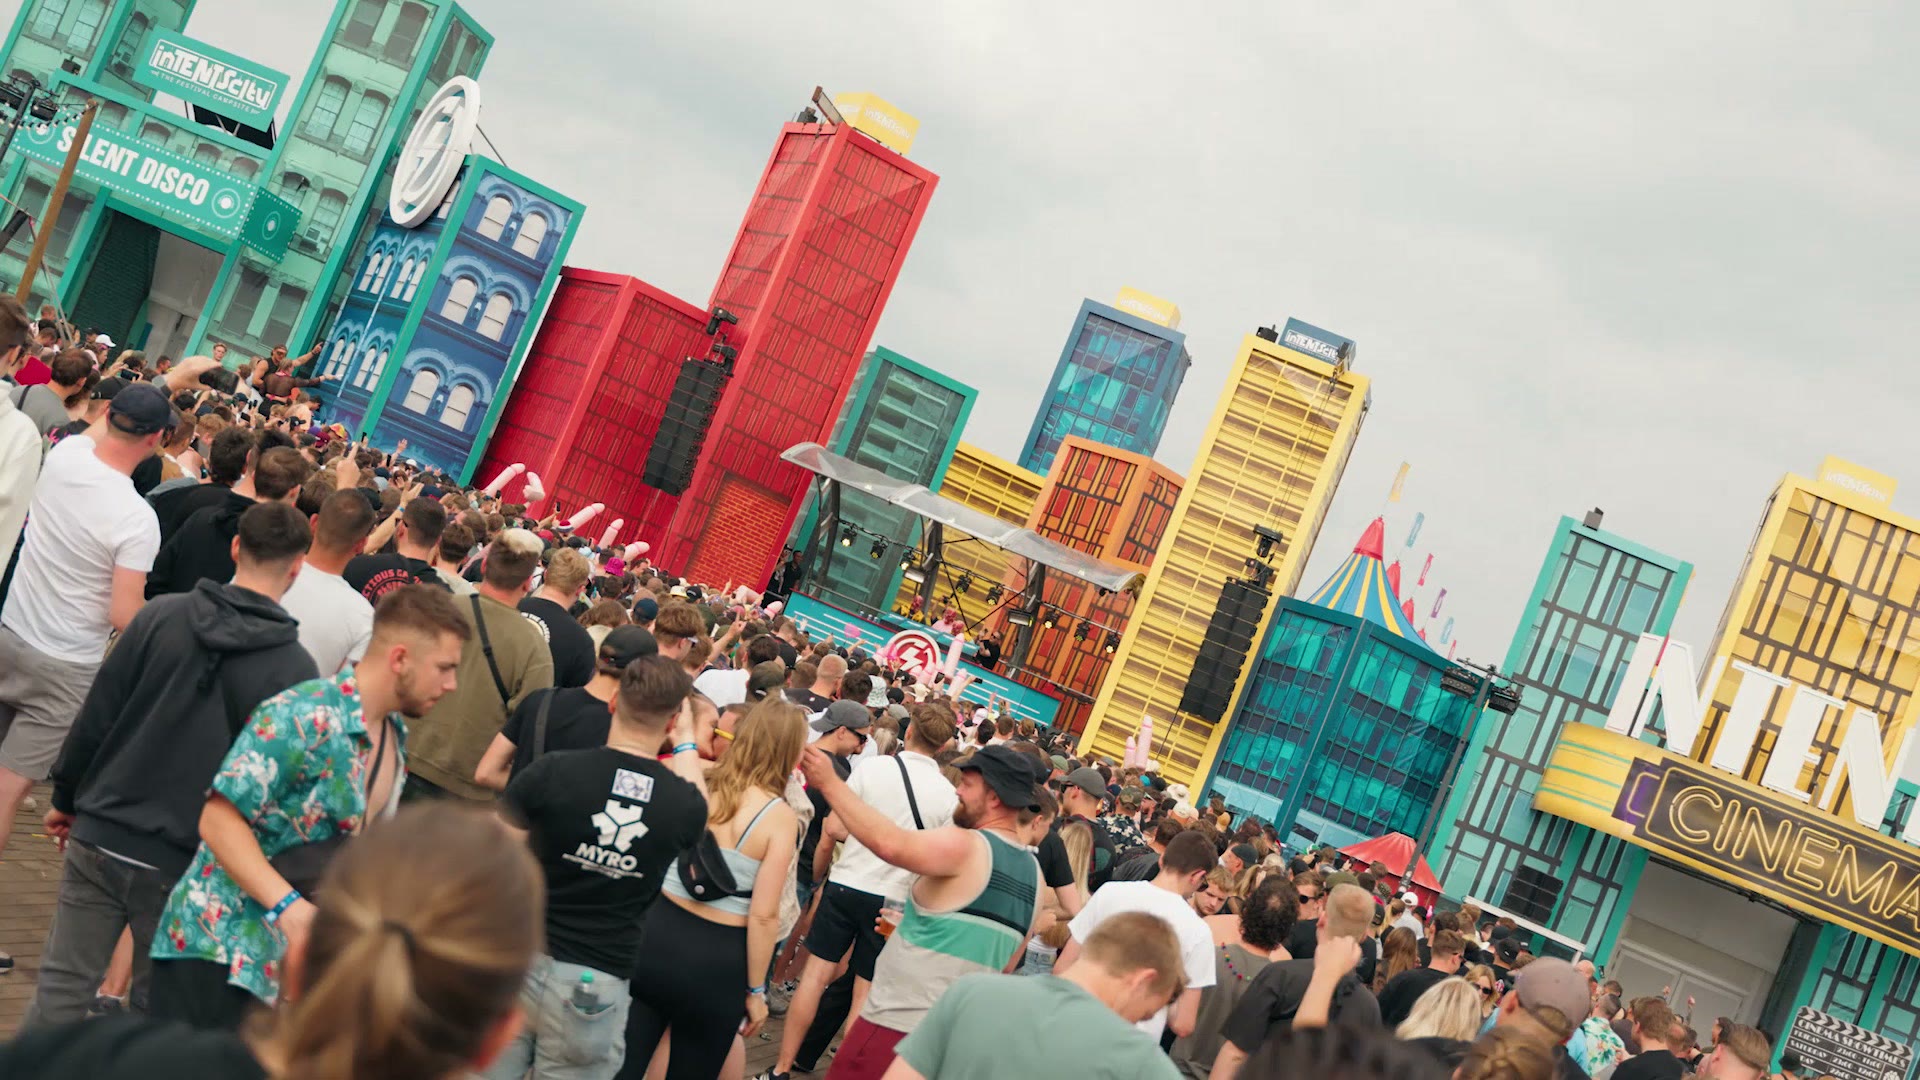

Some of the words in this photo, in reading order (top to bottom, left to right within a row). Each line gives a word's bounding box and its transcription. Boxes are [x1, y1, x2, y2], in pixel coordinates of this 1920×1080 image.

[160, 73, 174, 83] THE
[176, 79, 211, 98] FESTIVAL
[212, 93, 251, 114] CAMPSITE
[56, 126, 140, 177] SLENT
[136, 156, 209, 206] DISCO
[575, 842, 638, 871] MYRO
[1669, 785, 1920, 932] CINEMA
[1790, 1040, 1827, 1058] SATURDAY
[1793, 1030, 1820, 1043] FRIDAY
[1798, 1019, 1840, 1042] CINEMA
[1842, 1036, 1905, 1067] SHOWTIMES
